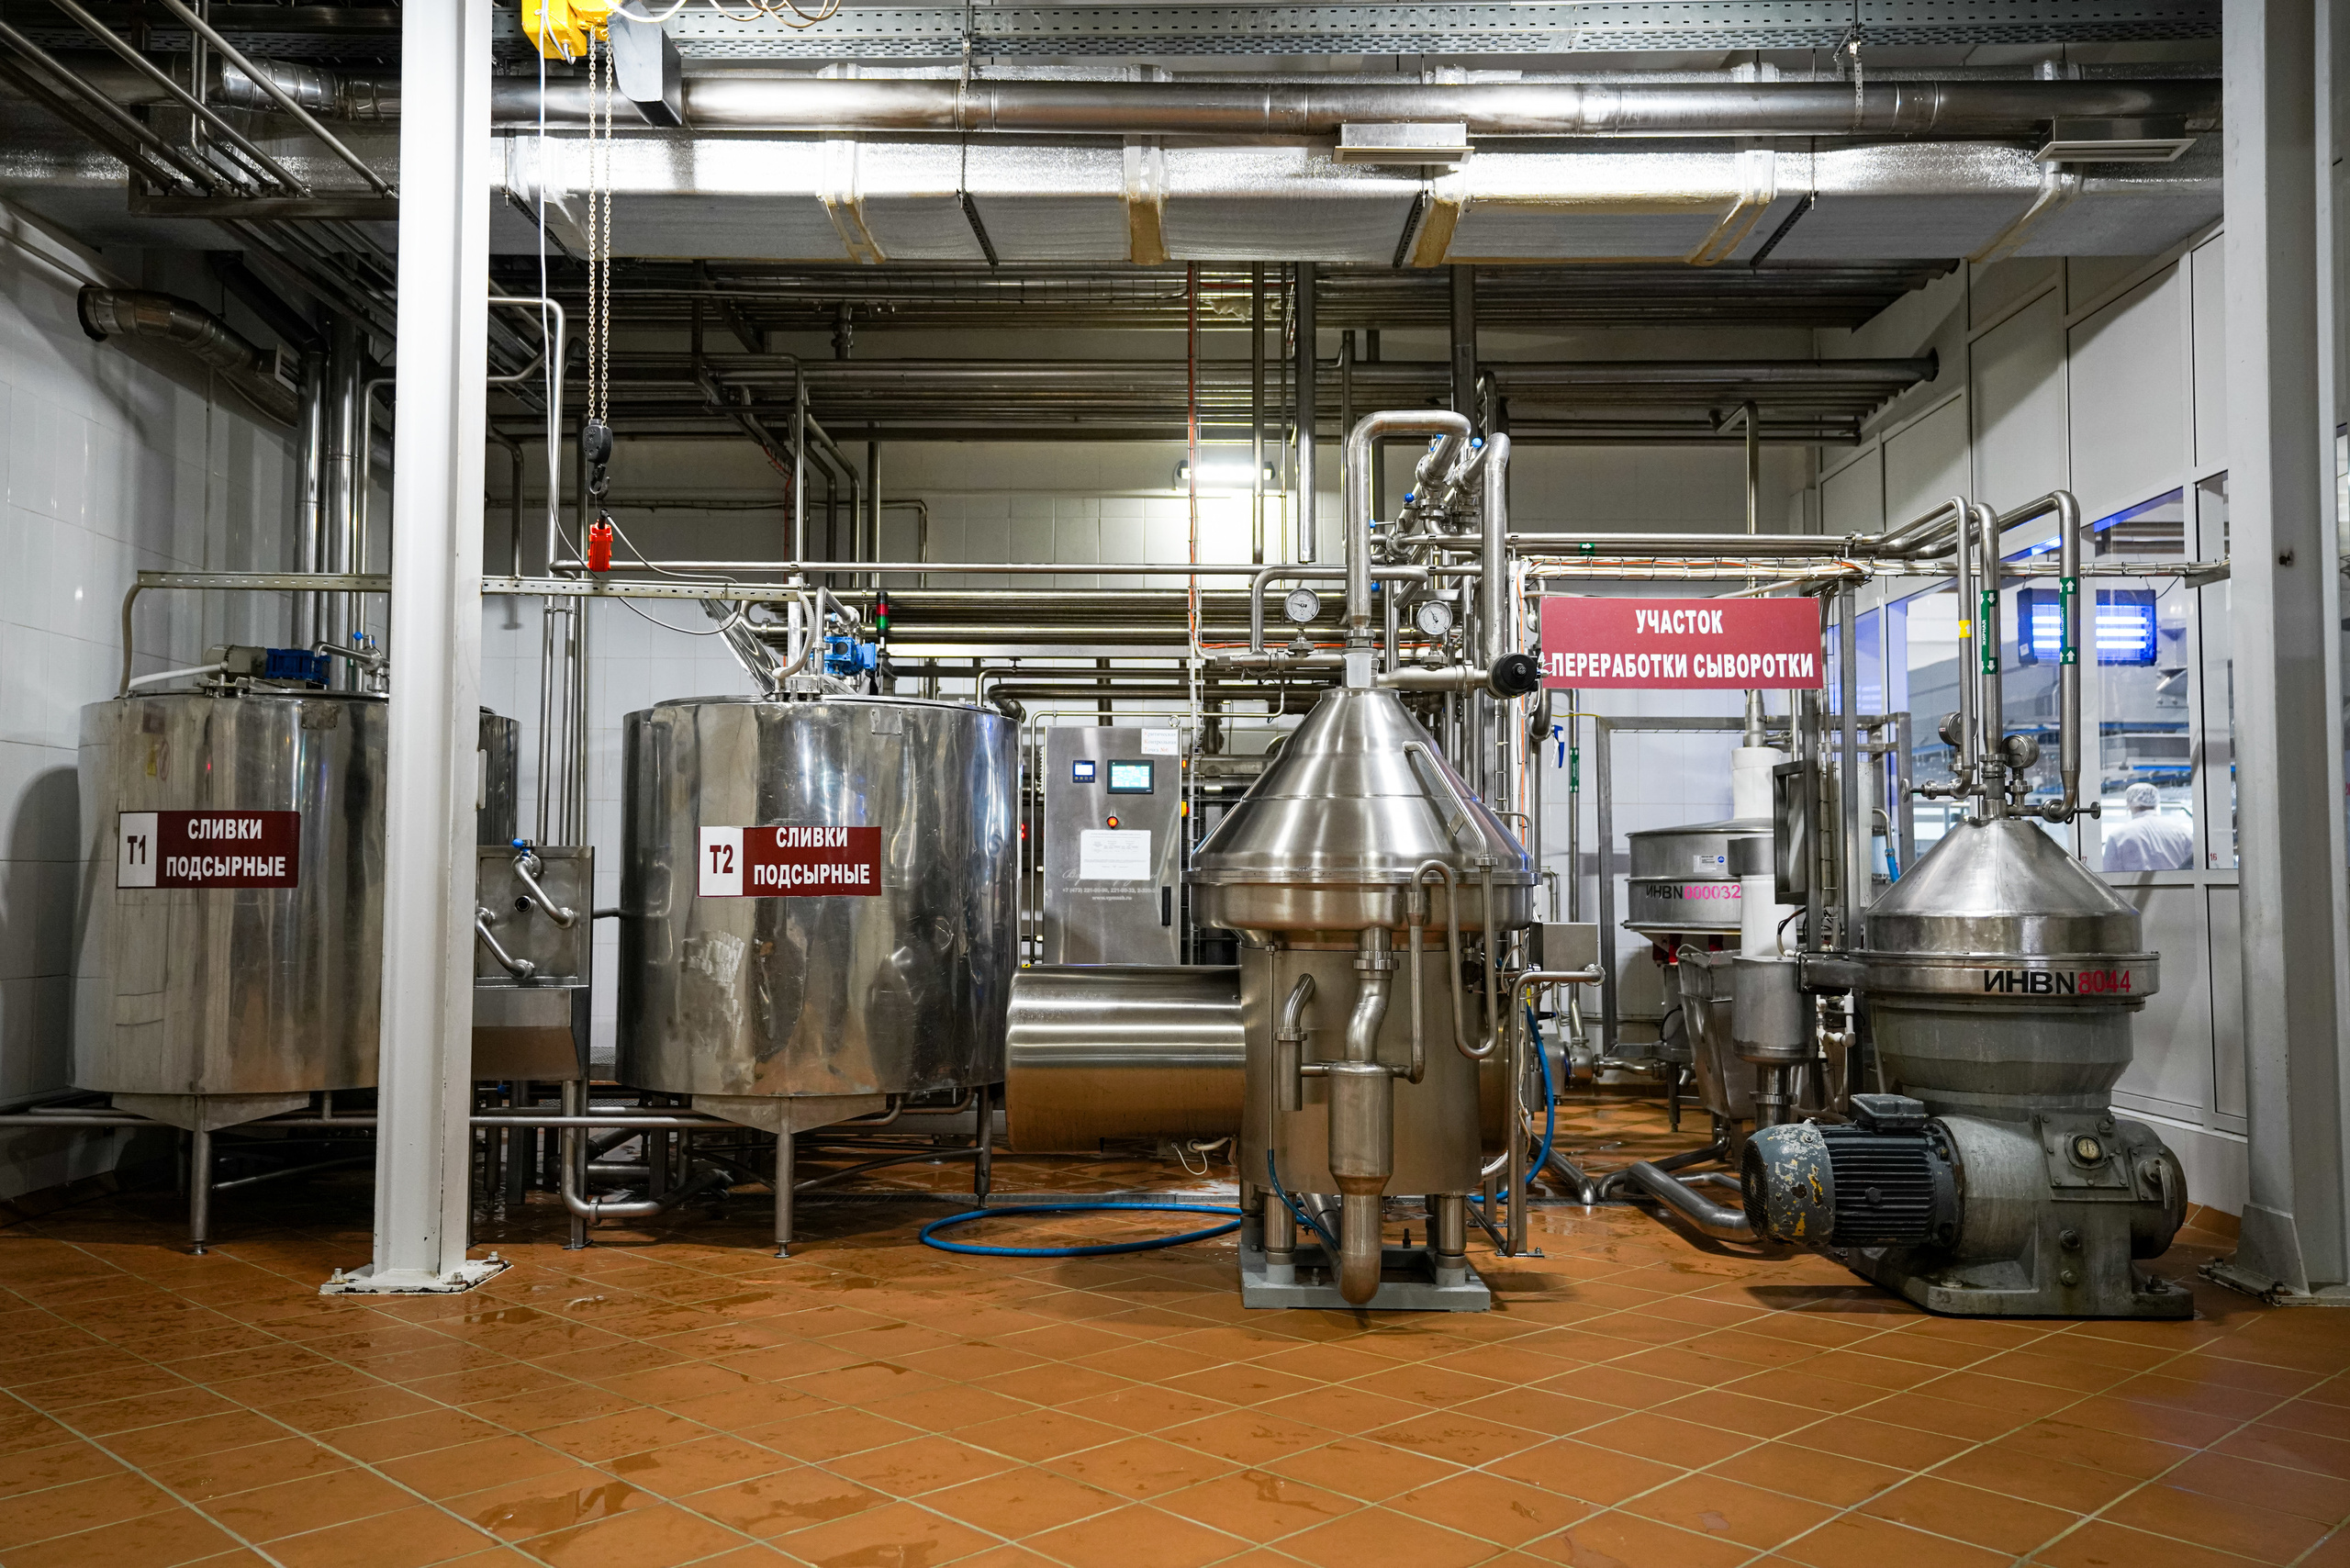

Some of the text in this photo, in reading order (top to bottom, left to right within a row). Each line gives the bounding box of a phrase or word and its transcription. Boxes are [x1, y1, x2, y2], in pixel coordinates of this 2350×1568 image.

[1635, 610, 1723, 634] УЧАСТОК
[1551, 652, 1814, 678] ПЕРЕРАБОТКИ СЫВОРОТКИ
[187, 819, 263, 839] СЛИВКИ
[776, 827, 848, 847] СЛИВКИ
[127, 834, 147, 865] Т1
[710, 844, 733, 874] Т2
[2210, 853, 2218, 861] 16
[166, 856, 286, 880] ПОДСЫРНЫЕ
[754, 864, 870, 889] ПОДСЫРНЫЕ
